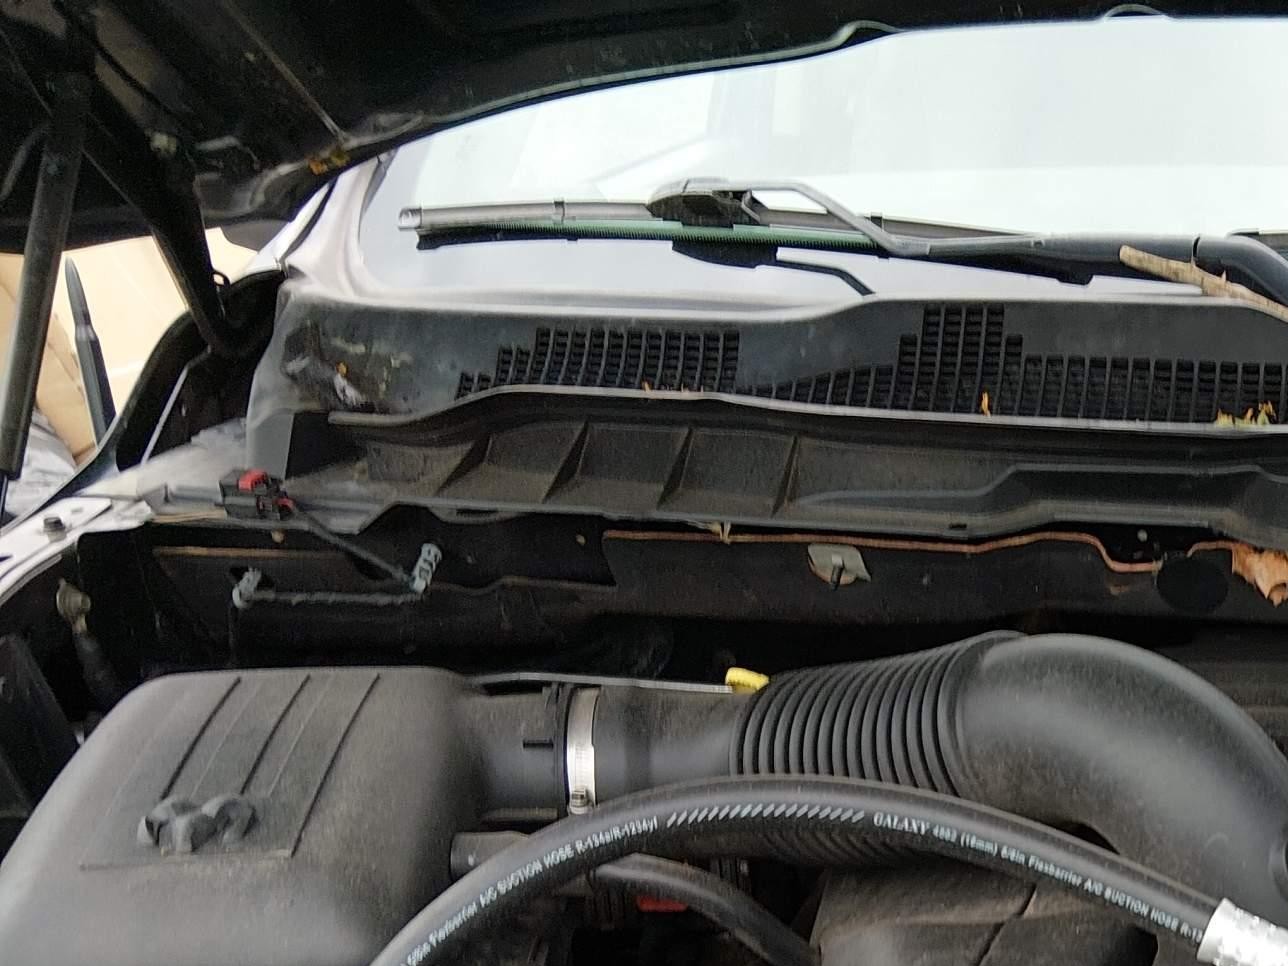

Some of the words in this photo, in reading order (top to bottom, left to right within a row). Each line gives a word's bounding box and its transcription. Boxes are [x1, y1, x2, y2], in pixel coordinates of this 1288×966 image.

[497, 860, 543, 894] SUCTION
[543, 843, 575, 869] HOSE
[874, 811, 930, 835] GALAXY
[1104, 886, 1150, 917] SUCTION
[1150, 906, 1179, 932] HOSE
